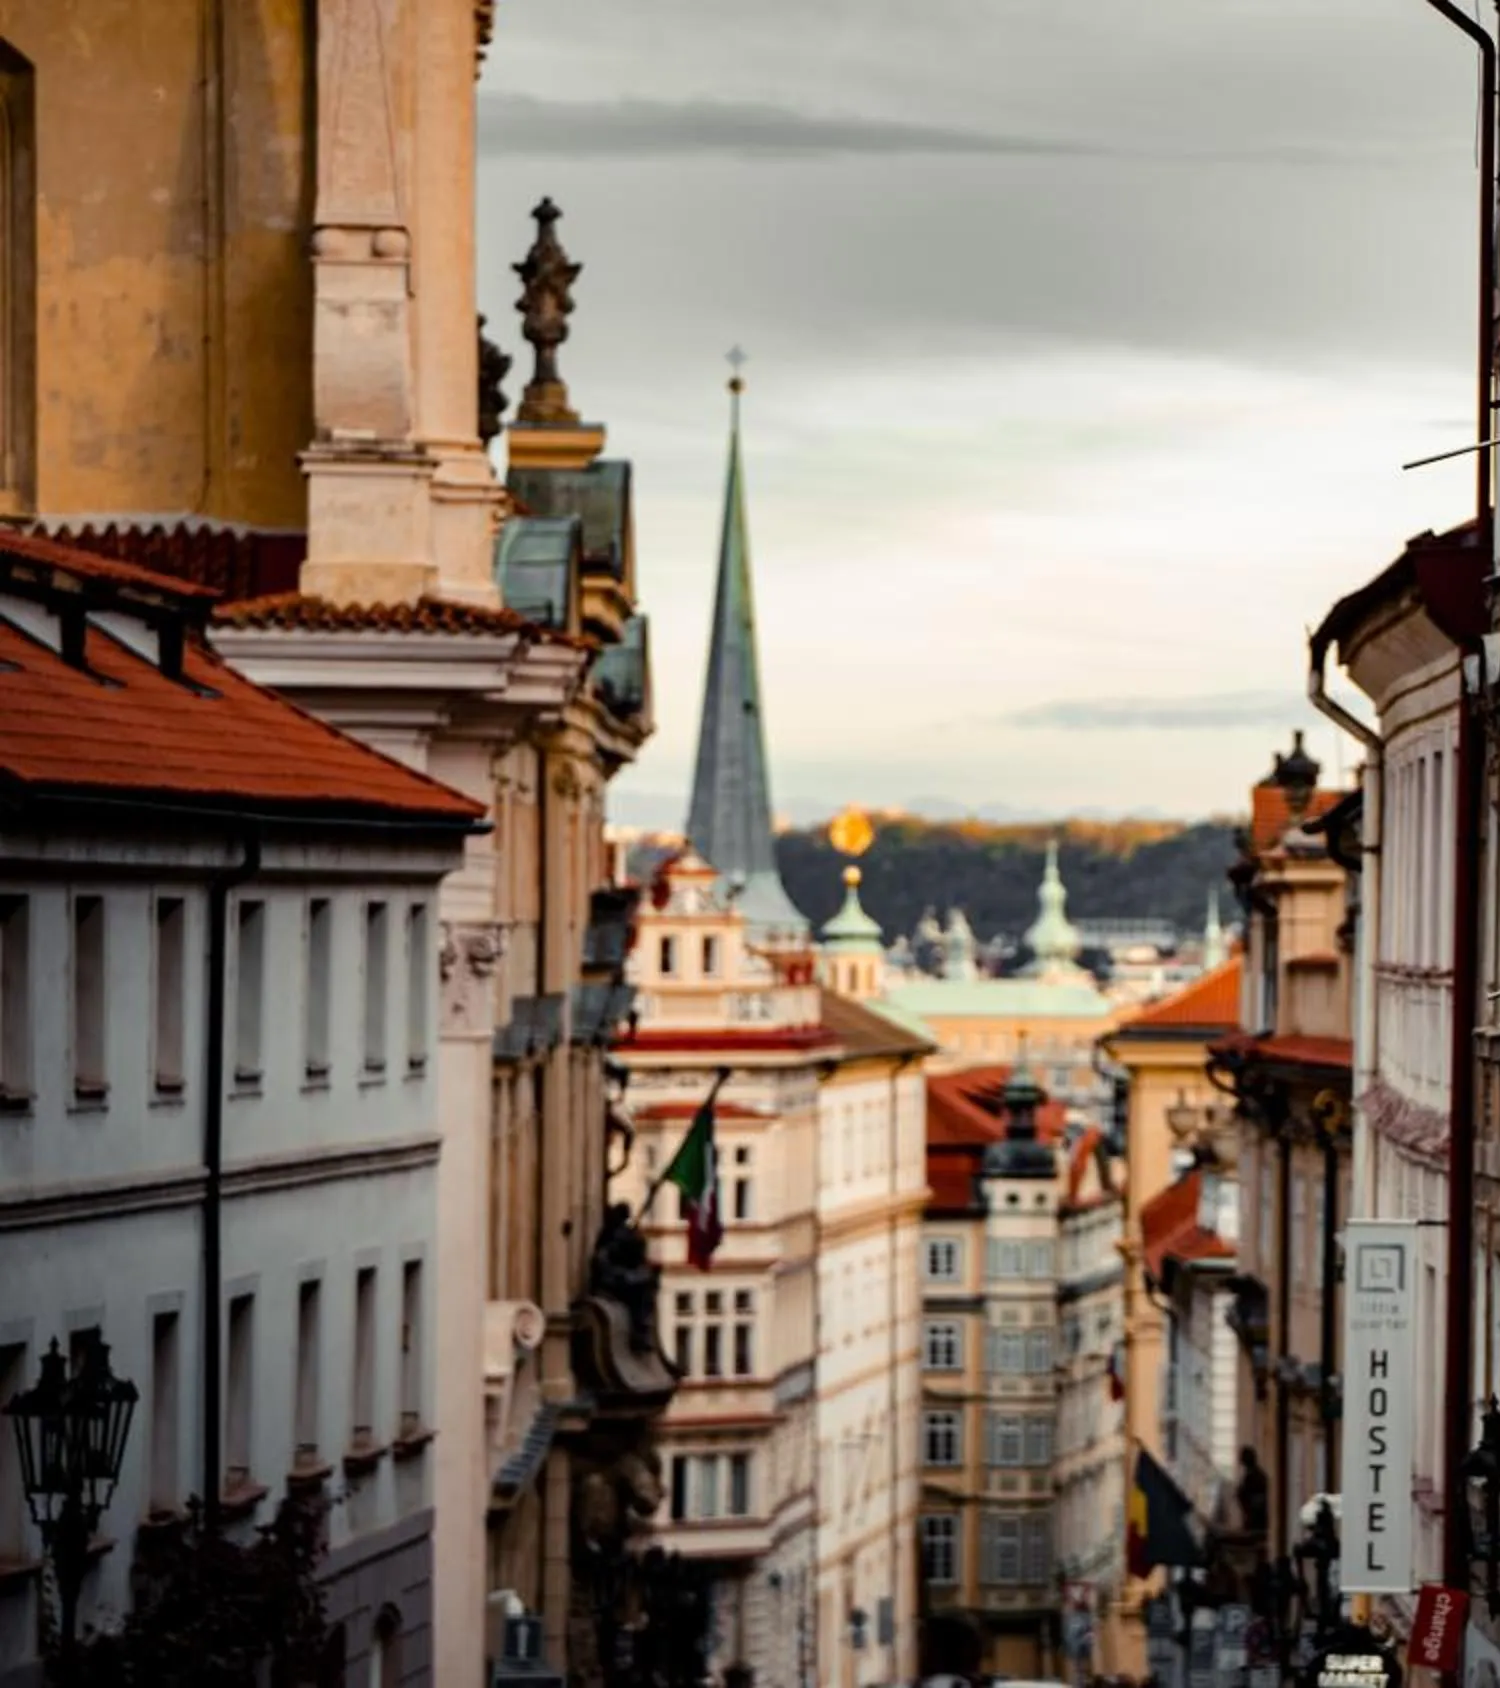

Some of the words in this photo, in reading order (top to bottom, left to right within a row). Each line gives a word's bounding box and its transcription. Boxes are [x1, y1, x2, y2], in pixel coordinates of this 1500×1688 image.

[1367, 1349, 1388, 1571] HOSTEL
[1422, 1593, 1452, 1661] change
[1325, 1654, 1384, 1671] SUPER
